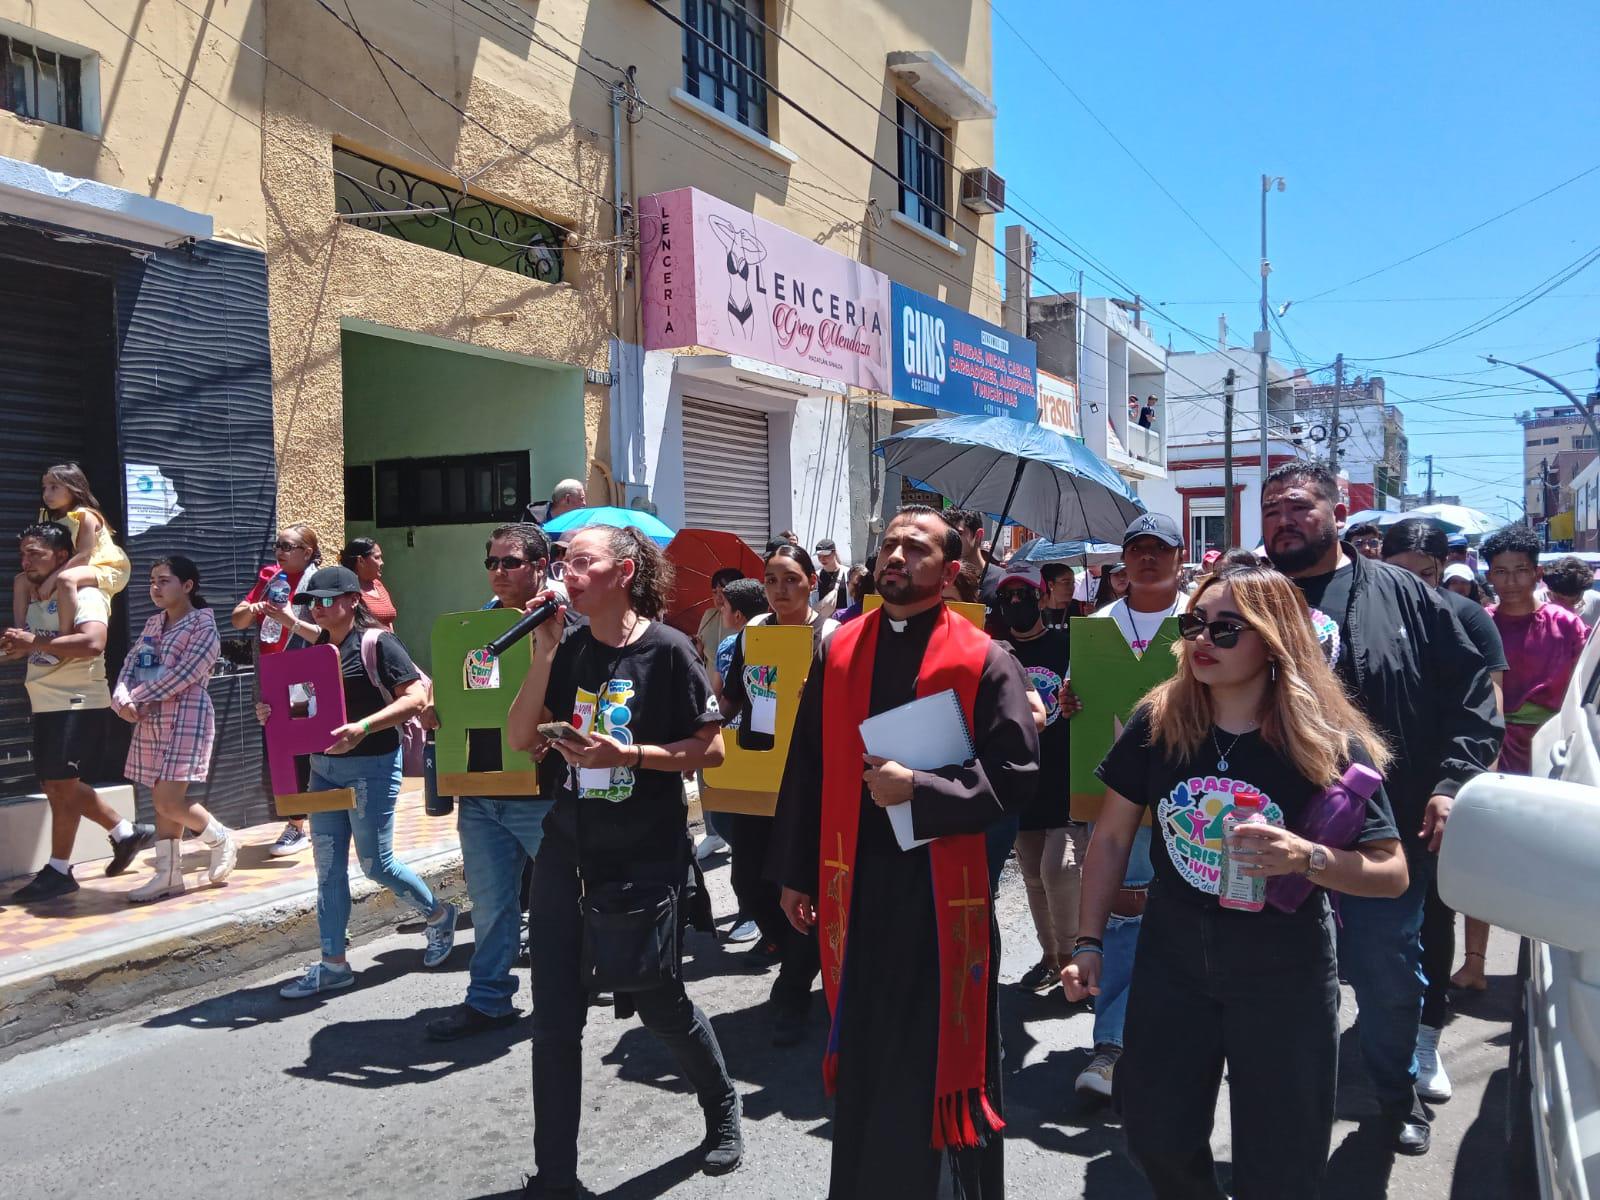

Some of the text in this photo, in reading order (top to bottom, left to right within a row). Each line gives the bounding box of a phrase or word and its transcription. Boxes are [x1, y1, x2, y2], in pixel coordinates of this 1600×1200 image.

[662, 207, 674, 333] LENCERIA
[755, 265, 882, 336] LENCERIA
[902, 305, 946, 383] GINS
[259, 643, 350, 800] P
[1201, 882, 1216, 893] del
